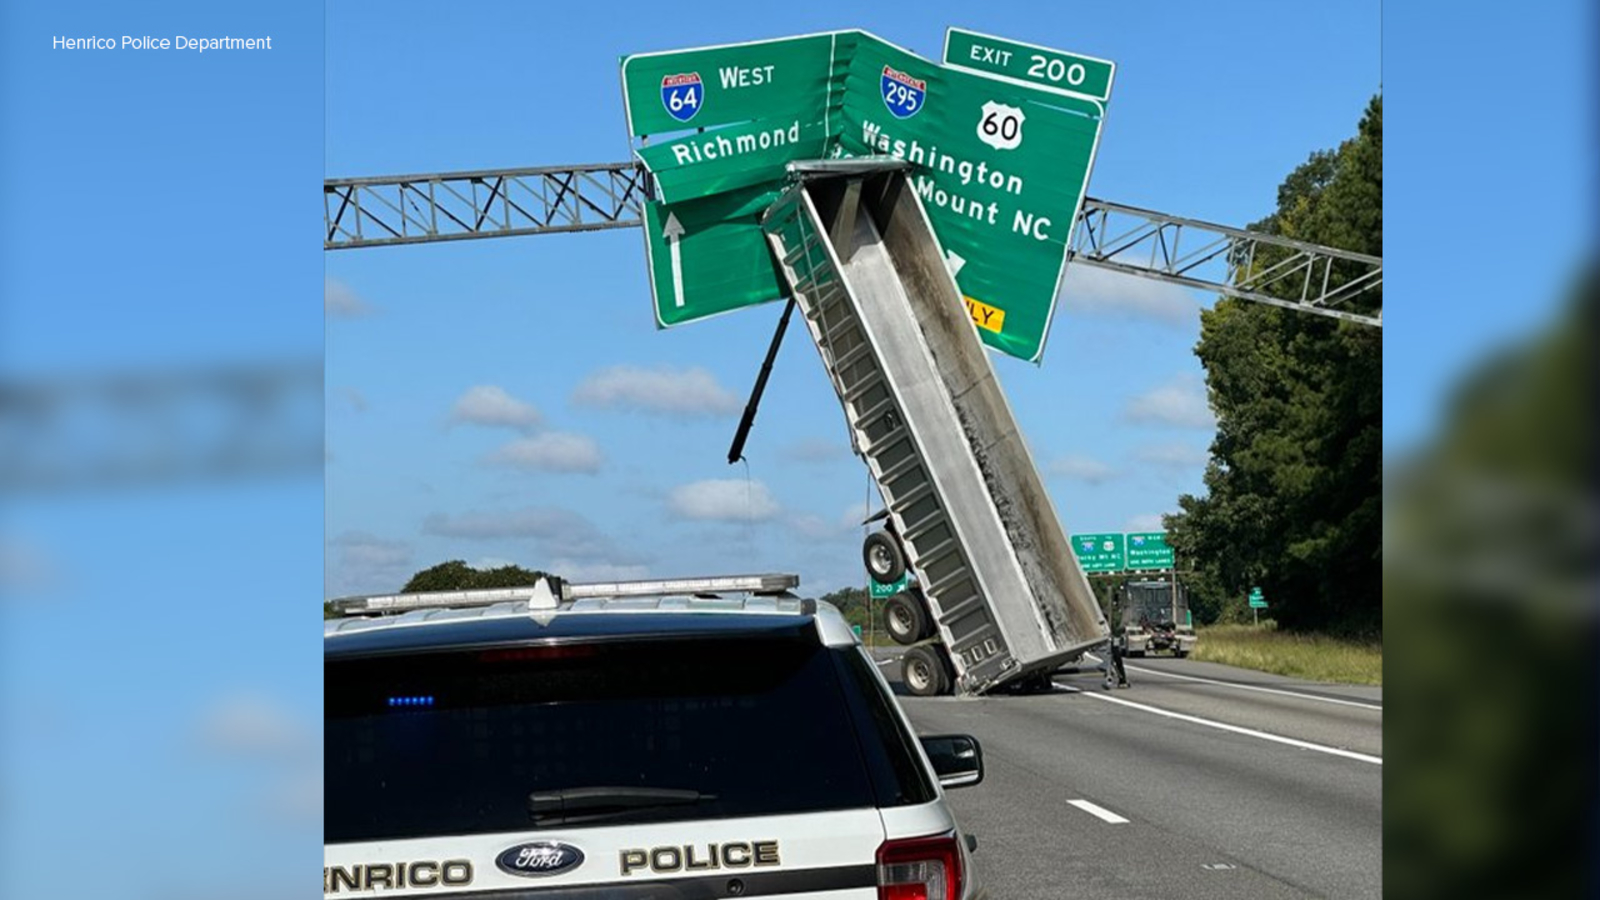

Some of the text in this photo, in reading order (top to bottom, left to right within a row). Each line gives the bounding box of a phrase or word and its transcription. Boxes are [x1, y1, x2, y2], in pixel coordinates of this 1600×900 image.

[719, 65, 775, 89] WEST
[970, 44, 1086, 86] EXIT 200
[669, 87, 698, 112] 64
[885, 81, 918, 112] 295
[982, 111, 1019, 141] 60
[671, 120, 800, 165] Richmond
[862, 120, 1023, 195] Washington
[917, 175, 1052, 241] Mount NC
[965, 301, 995, 325] LY
[876, 584, 893, 593] 200
[514, 845, 563, 868] Ford
[619, 839, 781, 876] POLICE
[324, 858, 474, 893] NRICO
